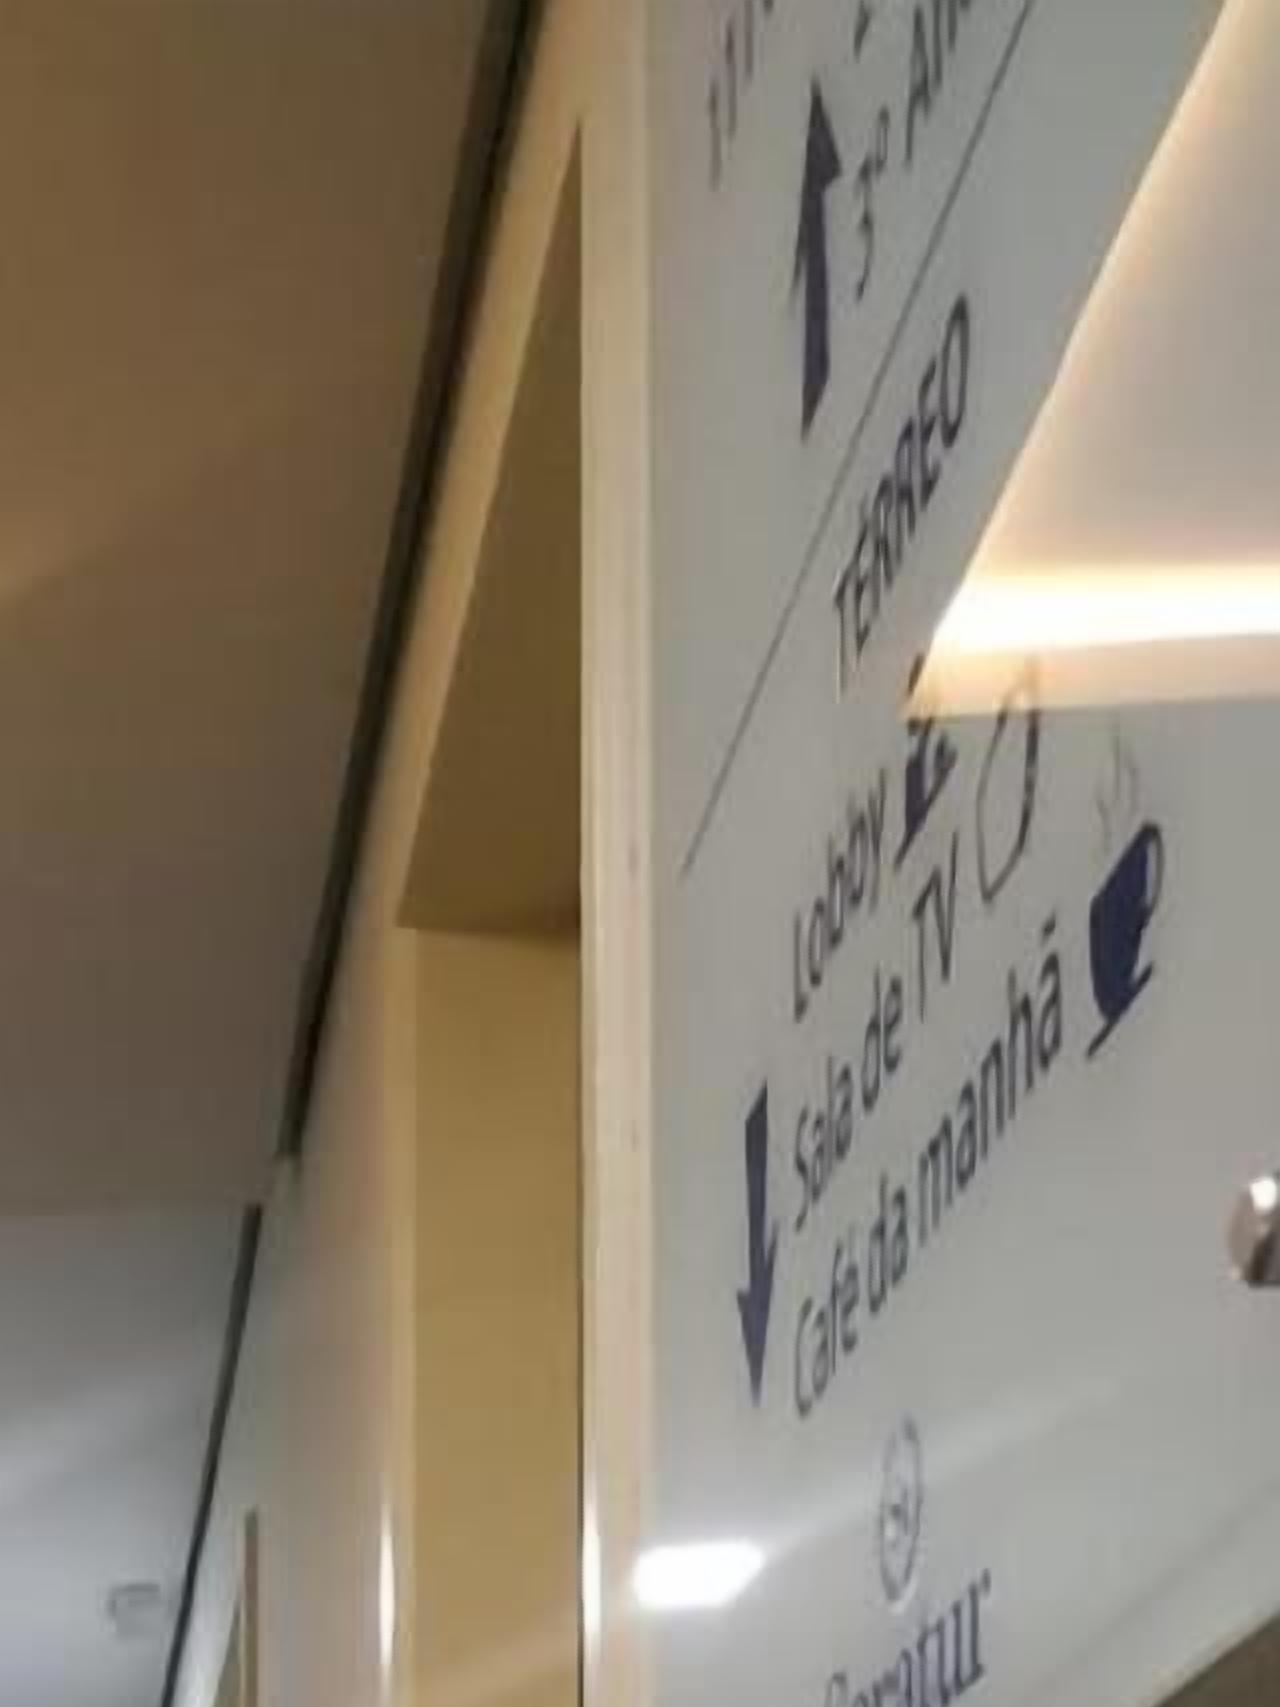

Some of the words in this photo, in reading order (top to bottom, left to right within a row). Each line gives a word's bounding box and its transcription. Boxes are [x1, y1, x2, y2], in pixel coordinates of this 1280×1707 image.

[792, 765, 887, 1024] Lobby
[794, 1052, 854, 1234] Sala
[862, 960, 903, 1112] de
[912, 828, 960, 1023] TV
[793, 1222, 860, 1418] Café
[867, 1168, 909, 1316] da
[917, 908, 1064, 1248] manhã
